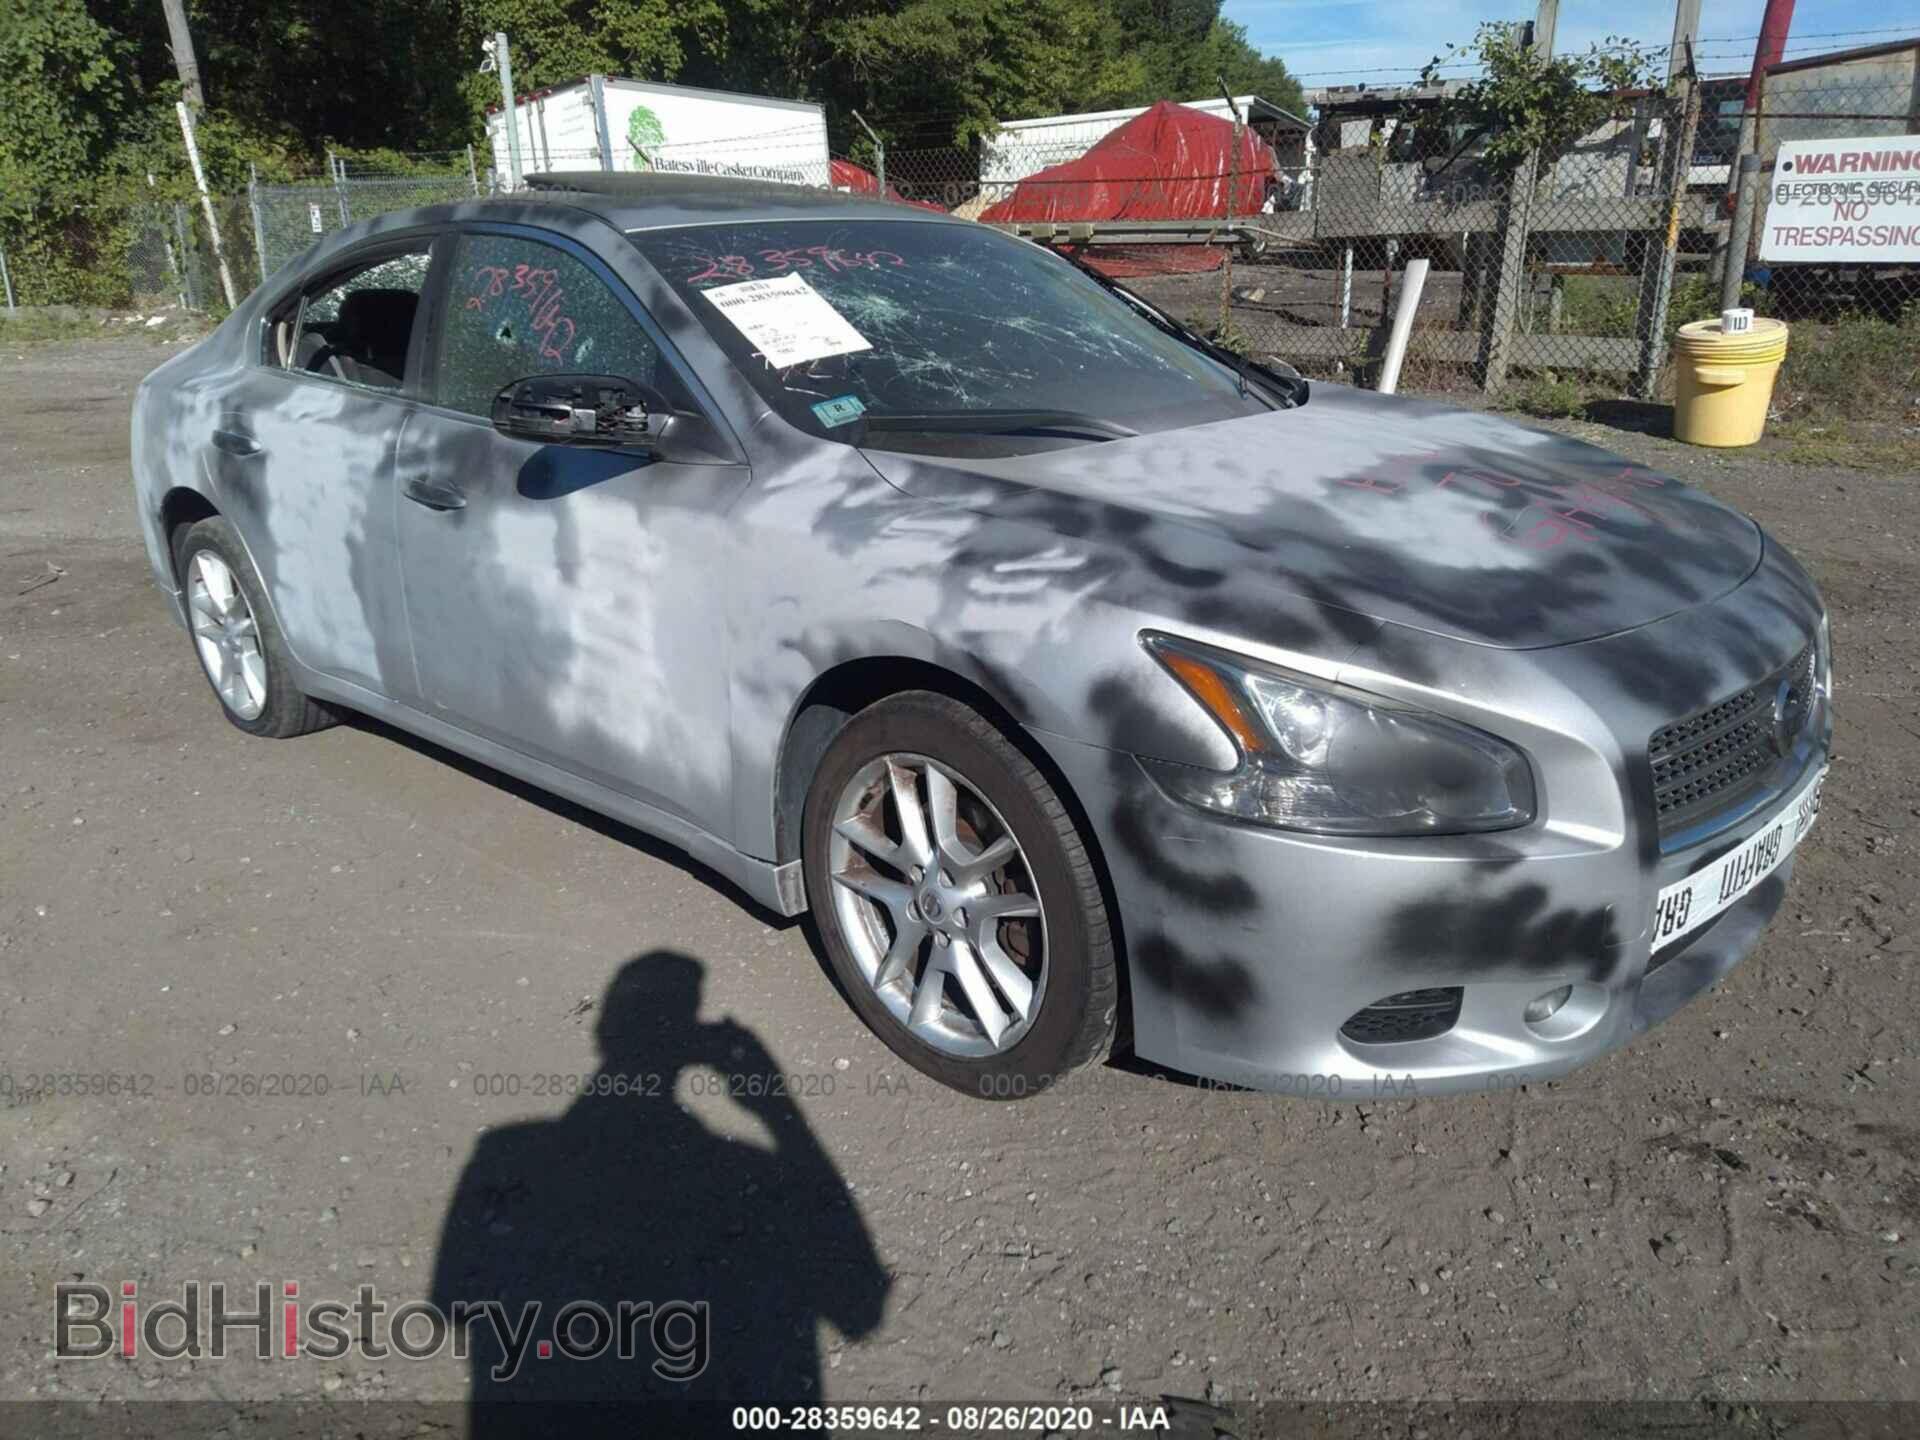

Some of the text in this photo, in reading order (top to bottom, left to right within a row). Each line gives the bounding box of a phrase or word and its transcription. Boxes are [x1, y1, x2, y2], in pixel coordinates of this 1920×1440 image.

[655, 157, 805, 184] Batesville Casket Company
[1833, 199, 1868, 221] NO
